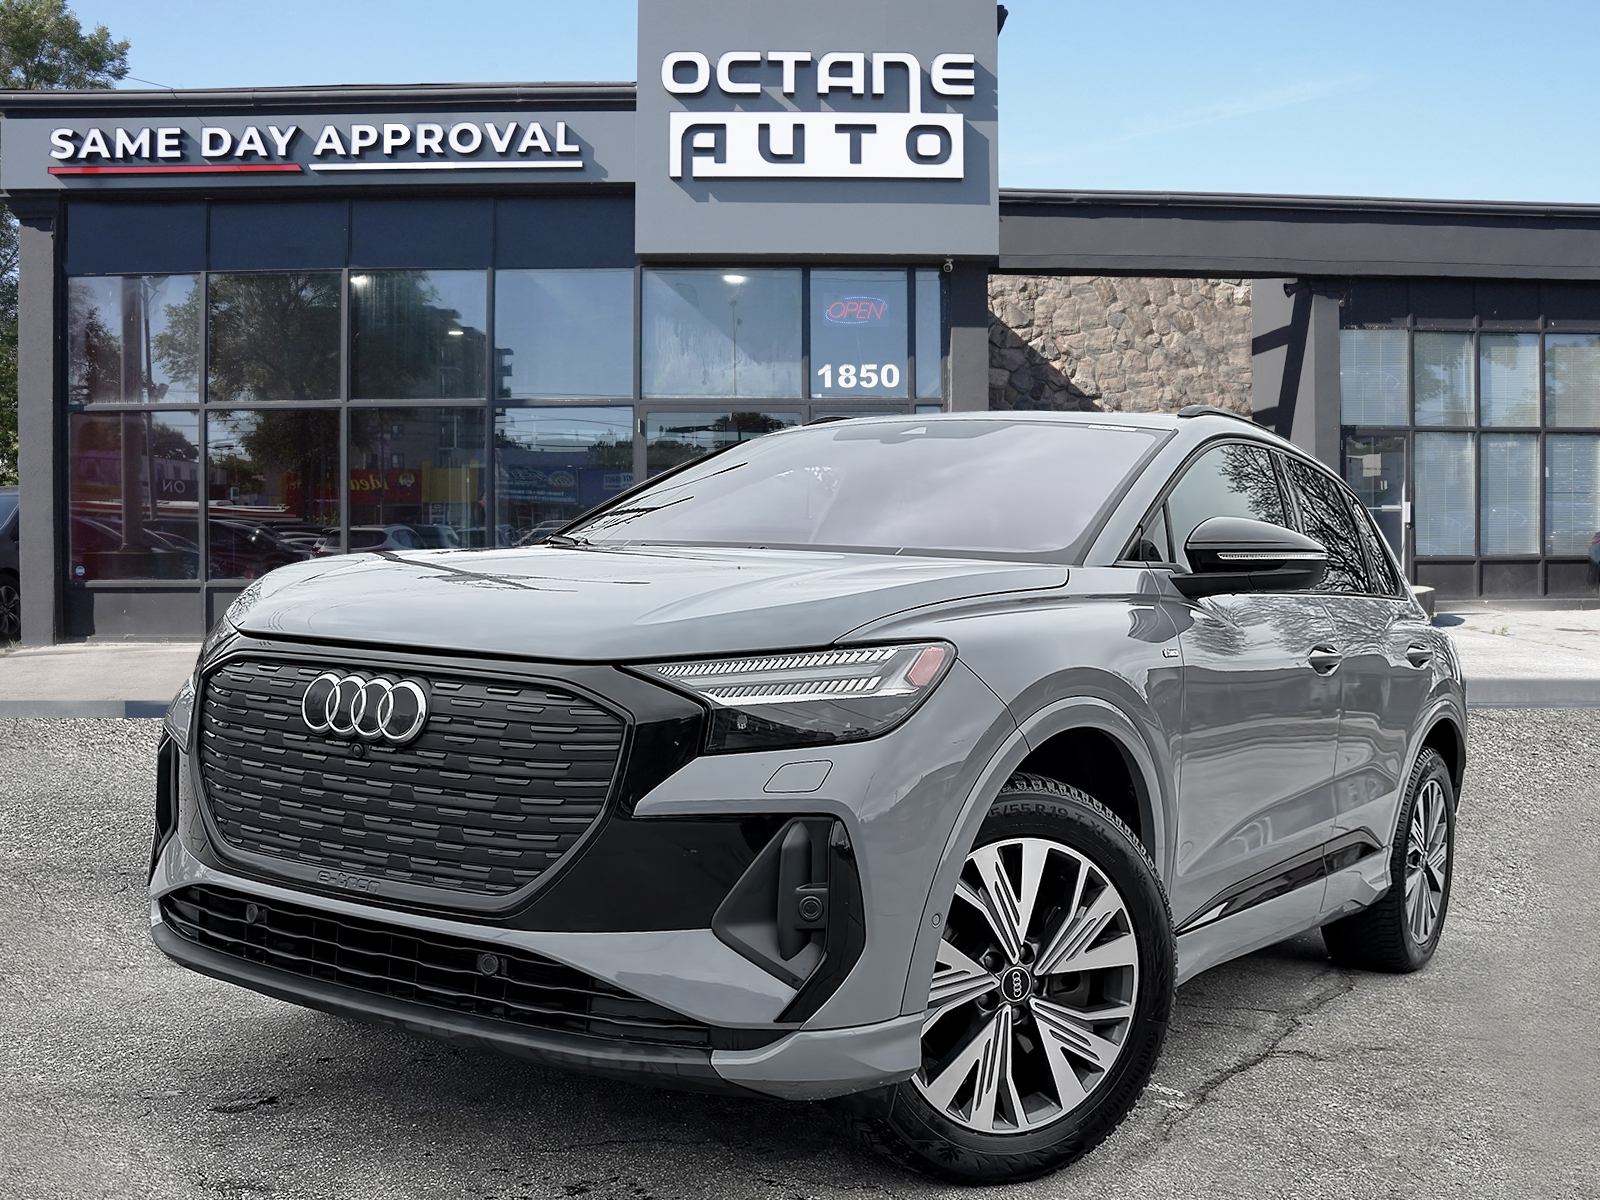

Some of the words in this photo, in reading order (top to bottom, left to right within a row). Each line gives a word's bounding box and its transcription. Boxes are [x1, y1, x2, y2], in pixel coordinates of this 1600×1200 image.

[661, 51, 975, 97] OCTANE
[49, 127, 182, 160] SAME
[201, 125, 299, 157] DAY
[313, 121, 580, 156] APPROVAL
[680, 123, 952, 177] AUTO
[828, 301, 885, 320] OPEN
[817, 363, 900, 389] 1850
[989, 803, 1032, 817] 5/55
[317, 870, 381, 894] e-tron
